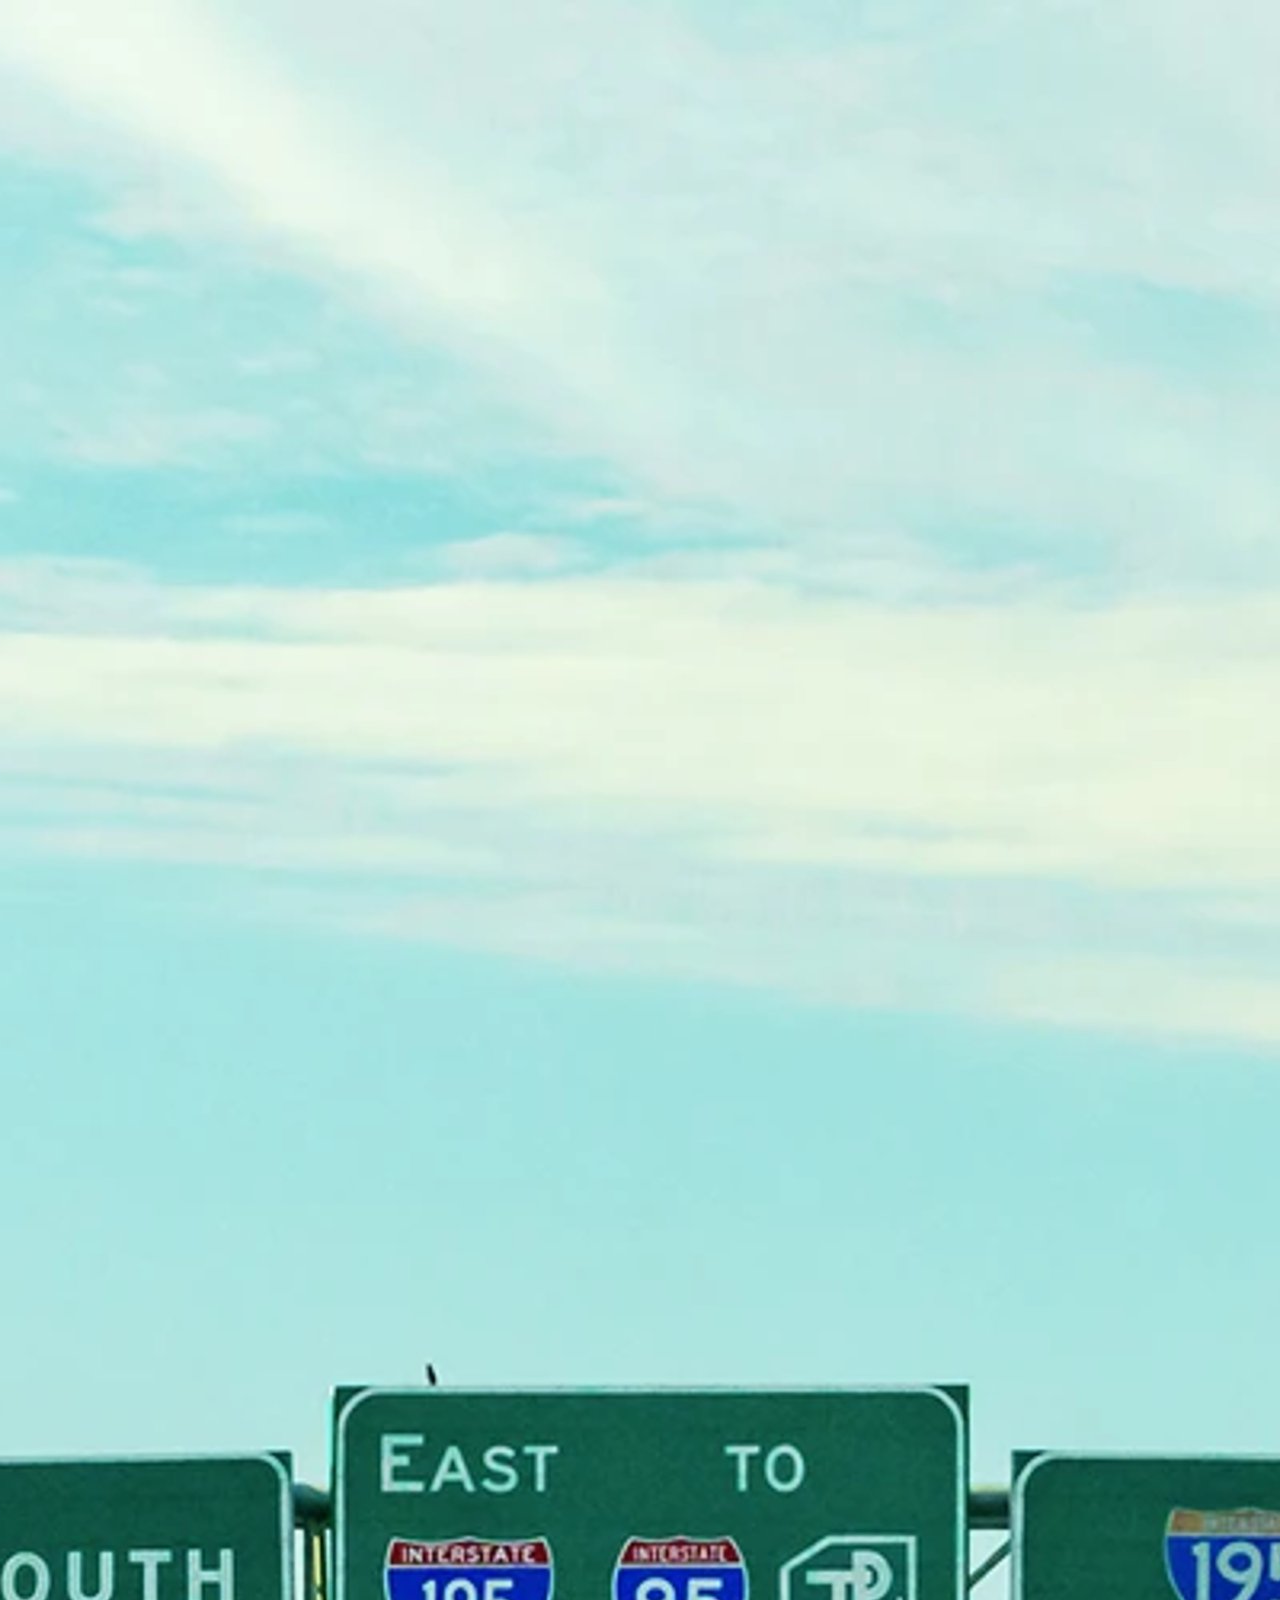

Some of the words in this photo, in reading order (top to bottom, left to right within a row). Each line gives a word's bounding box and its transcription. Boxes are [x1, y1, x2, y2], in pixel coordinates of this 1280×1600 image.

[380, 1433, 558, 1494] EAST
[724, 1444, 805, 1494] TO
[401, 1546, 536, 1563] INTERSTATE
[632, 1546, 728, 1563] INTERSTATE
